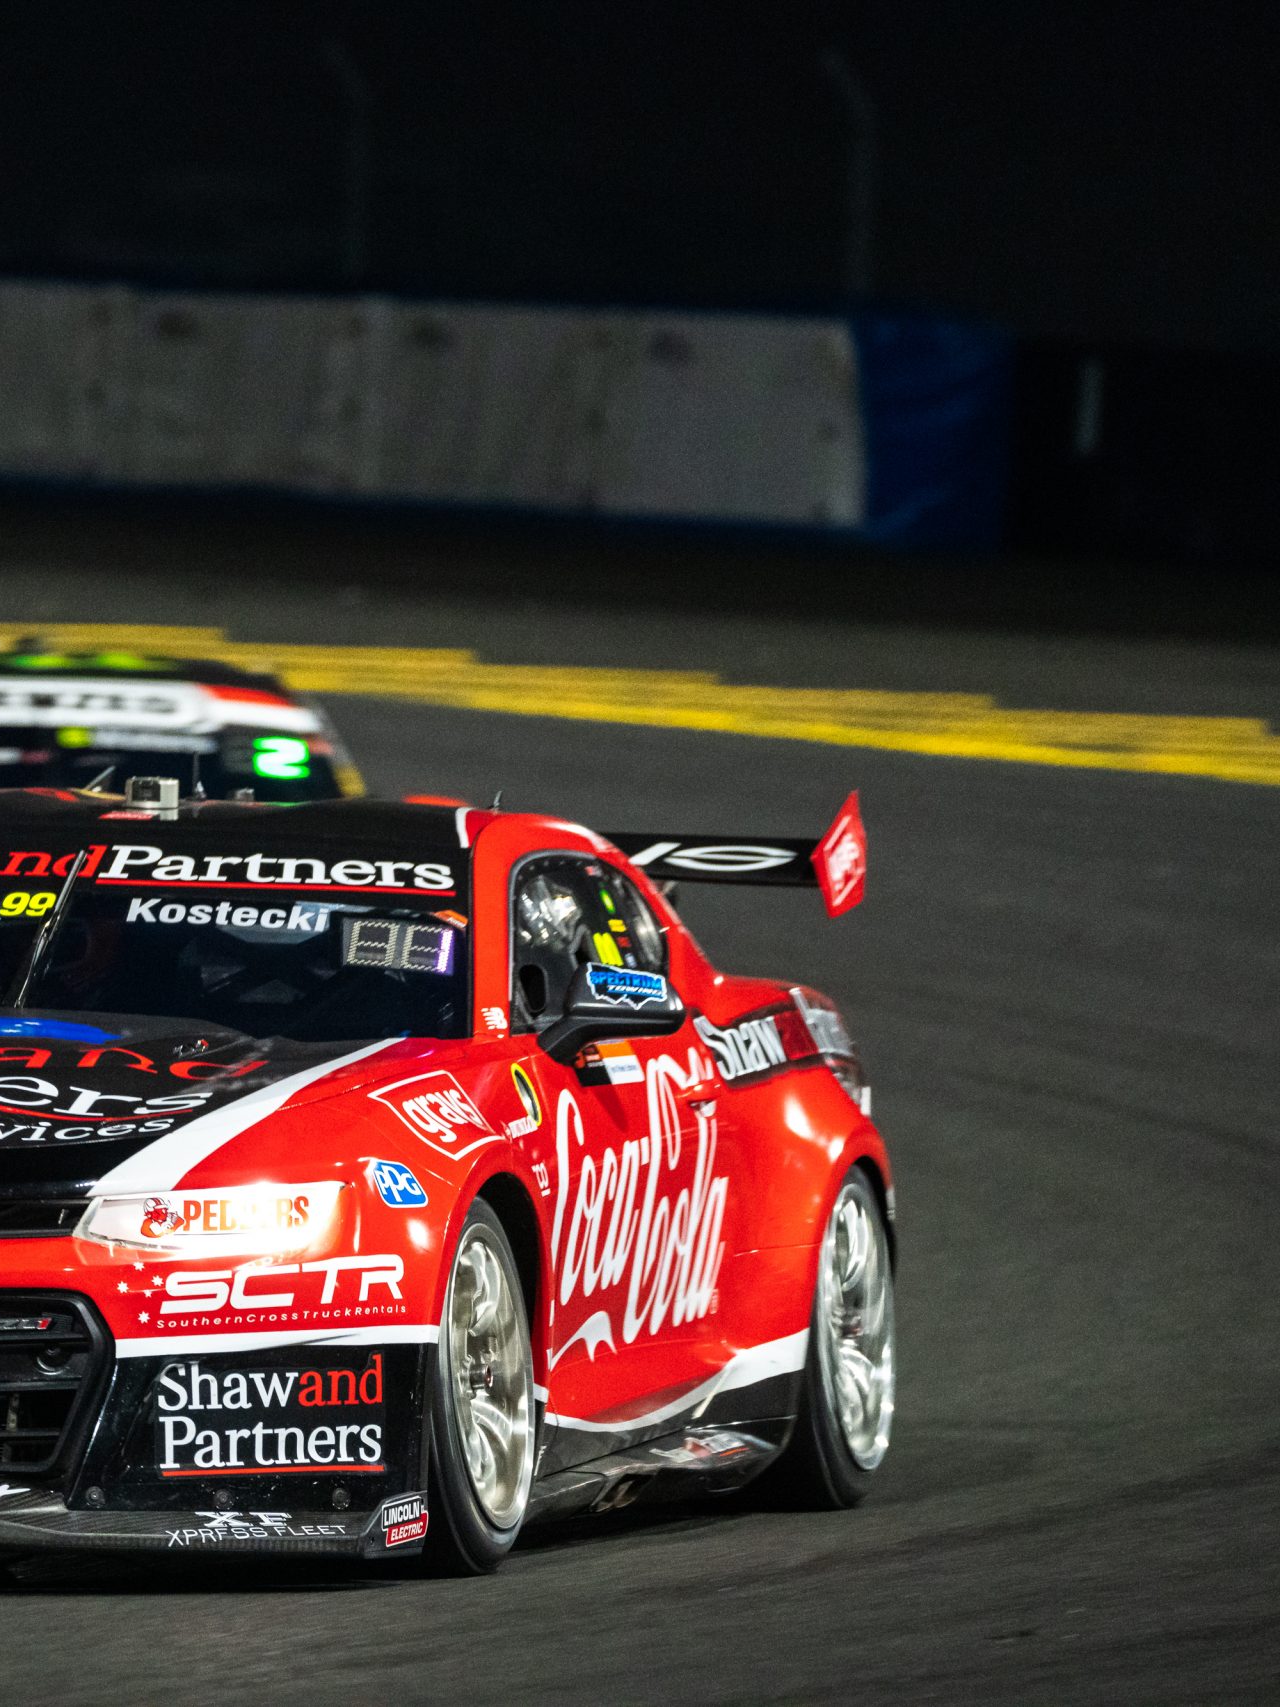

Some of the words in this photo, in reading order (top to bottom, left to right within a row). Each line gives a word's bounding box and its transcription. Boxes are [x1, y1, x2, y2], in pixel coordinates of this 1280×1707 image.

[252, 735, 311, 781] 2
[0, 891, 58, 917] 99
[125, 897, 331, 933] Kostecki
[375, 1164, 422, 1203] PPG
[159, 1254, 405, 1315] SCTR
[158, 1416, 382, 1469] Partners
[270, 1524, 347, 1537] FLEET
[383, 1500, 421, 1526] LINCOLN
[390, 1521, 424, 1542] ELECTRIC
